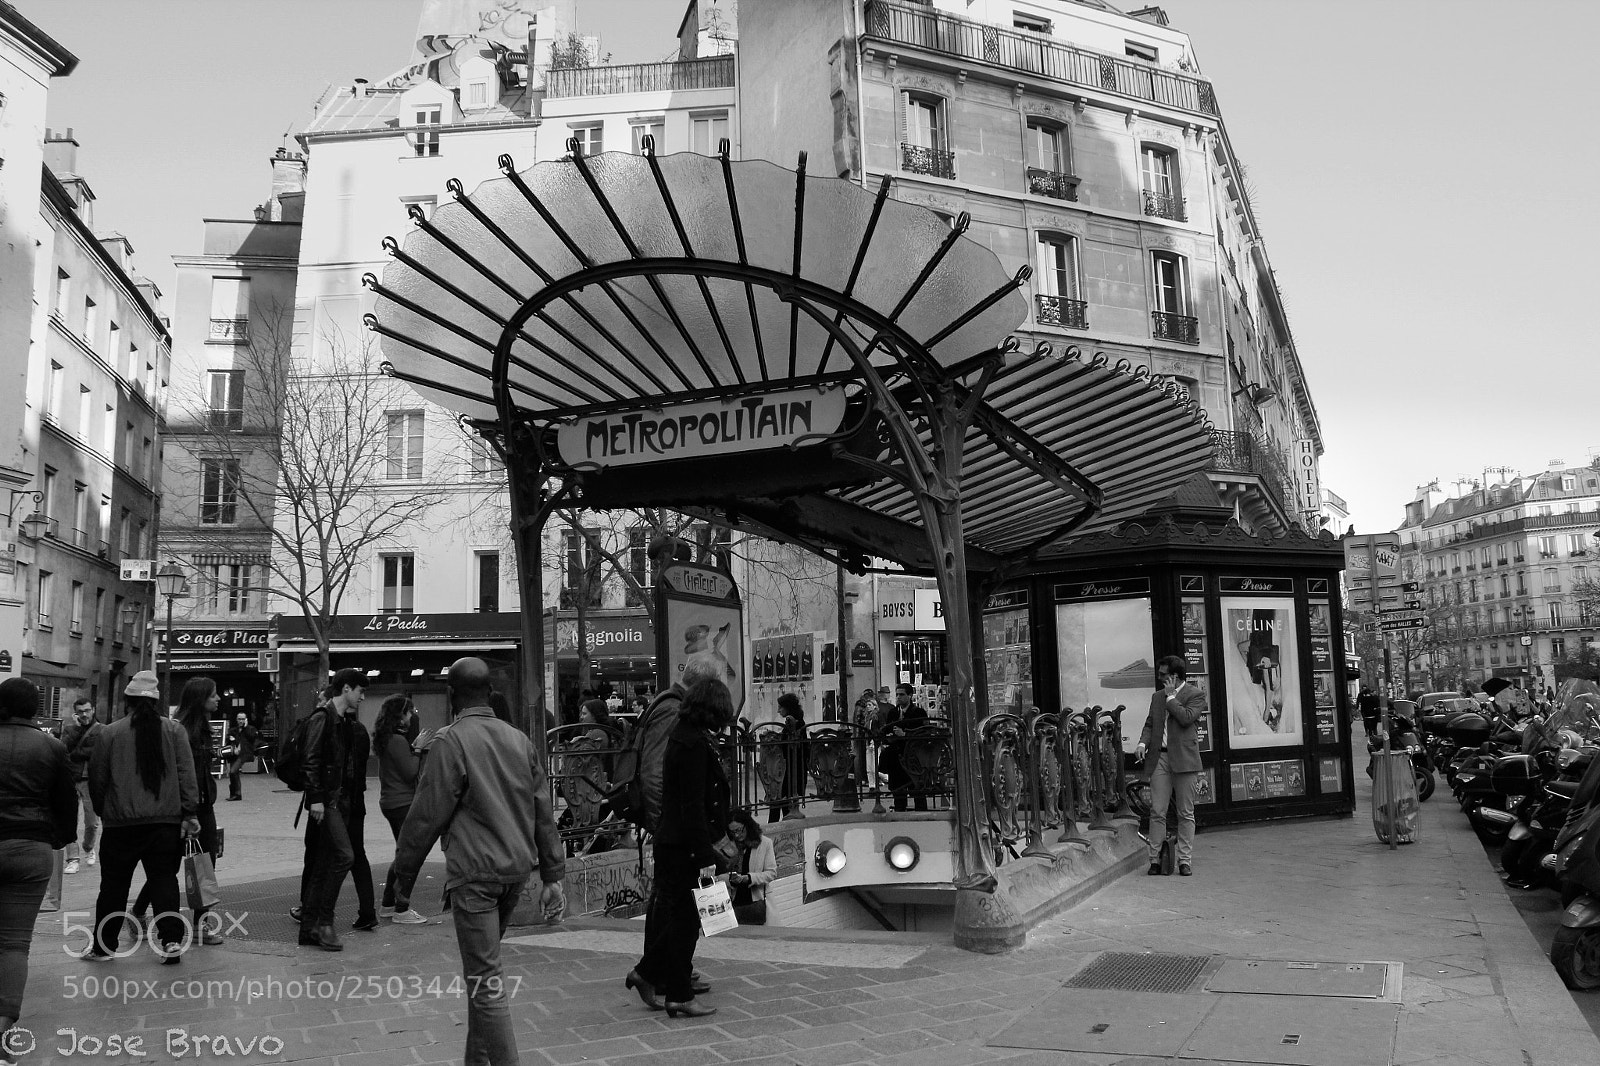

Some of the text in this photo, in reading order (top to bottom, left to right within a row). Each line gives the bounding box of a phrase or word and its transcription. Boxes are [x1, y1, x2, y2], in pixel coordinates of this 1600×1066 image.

[586, 397, 812, 458] METROPOLITAIN
[1301, 441, 1316, 508] HOTEL
[1080, 584, 1121, 596] Presse
[1240, 578, 1273, 591] Presse
[987, 594, 1012, 608] Presse
[882, 602, 914, 619] BOYS'S
[363, 615, 428, 631] Le Pacha
[1236, 616, 1283, 631] CÉLINE
[232, 631, 268, 644] Plac
